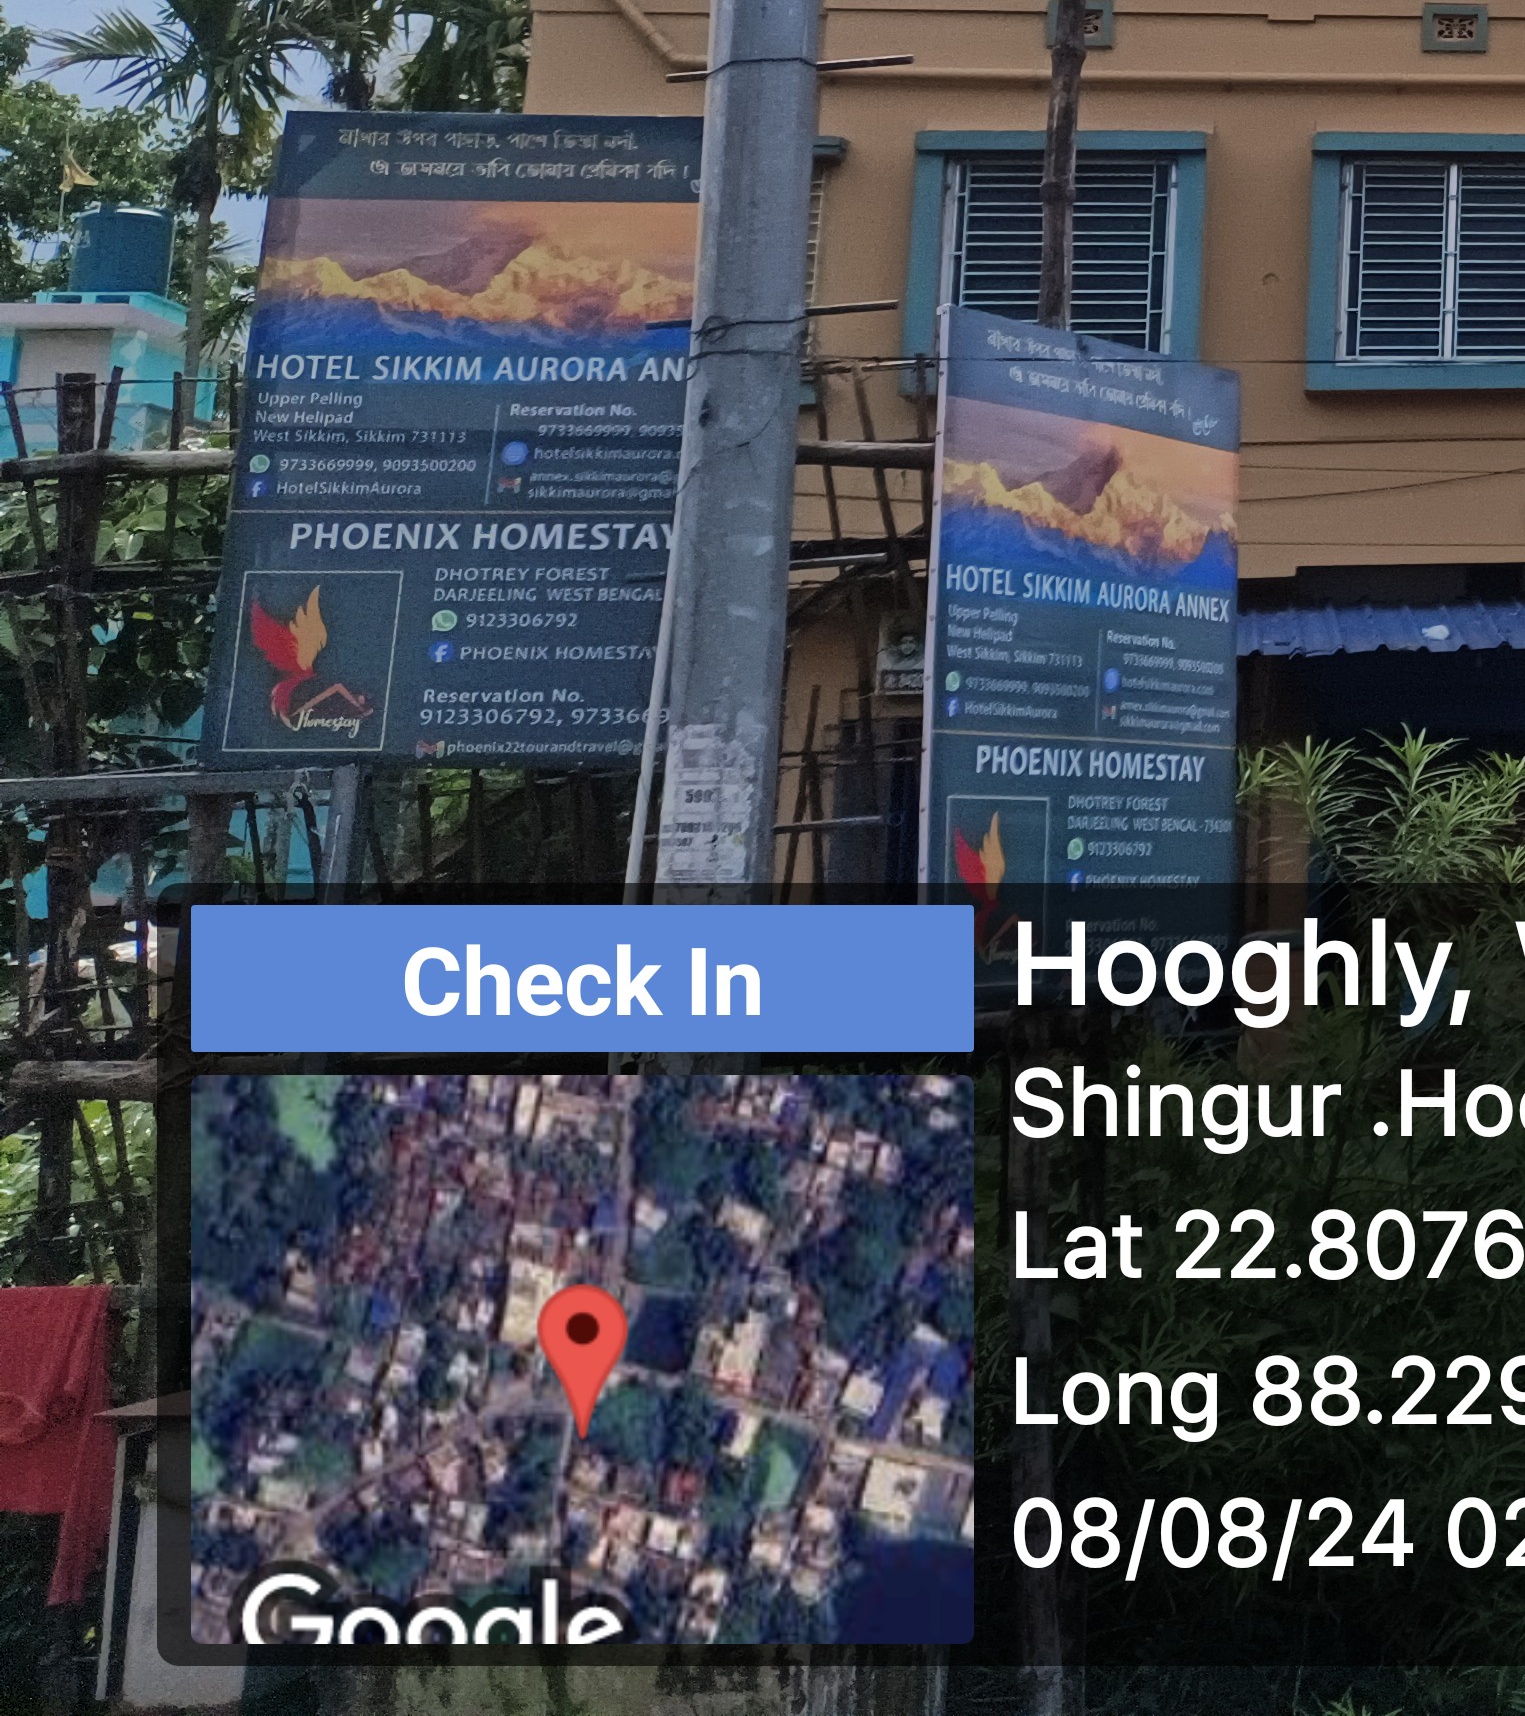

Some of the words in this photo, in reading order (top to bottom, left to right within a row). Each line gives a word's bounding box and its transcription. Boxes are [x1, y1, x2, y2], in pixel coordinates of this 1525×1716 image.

[256, 354, 361, 381] HOTEL
[371, 355, 483, 382] SIKKIM
[493, 355, 628, 383] AURORA
[638, 356, 693, 383] AN
[258, 392, 305, 407] Upper
[310, 391, 363, 408] Pelling
[509, 403, 605, 417] Reservation
[610, 404, 637, 417] No.
[255, 410, 289, 423] New
[294, 411, 354, 426] Helipad
[253, 429, 289, 443] West
[295, 429, 349, 444] Sikkim,
[355, 429, 405, 443] Sikkim
[382, 458, 476, 472] 9093500200
[276, 481, 422, 495] HotelSikkimAurora
[289, 522, 461, 551] PHOENIX
[435, 567, 530, 582] DHOTREY
[535, 567, 610, 582] FOREST
[433, 587, 537, 602] DARJEELING
[547, 587, 592, 602] WEST
[597, 587, 663, 602] BENGAL
[946, 563, 1016, 596] HOTEL
[1022, 572, 1091, 605] SIKKIM
[1096, 581, 1171, 615] AURORA
[1175, 592, 1230, 623] ANNEX
[466, 613, 578, 628] 9123306792
[460, 646, 548, 661] PHOENIX
[946, 644, 972, 659] West
[423, 688, 544, 704] Reservation
[552, 688, 585, 703] No.
[419, 708, 563, 727] 9123306792,
[976, 744, 1083, 777] PHOENIX
[1089, 748, 1207, 783] HOMESTAY
[1126, 796, 1170, 811] FOREST
